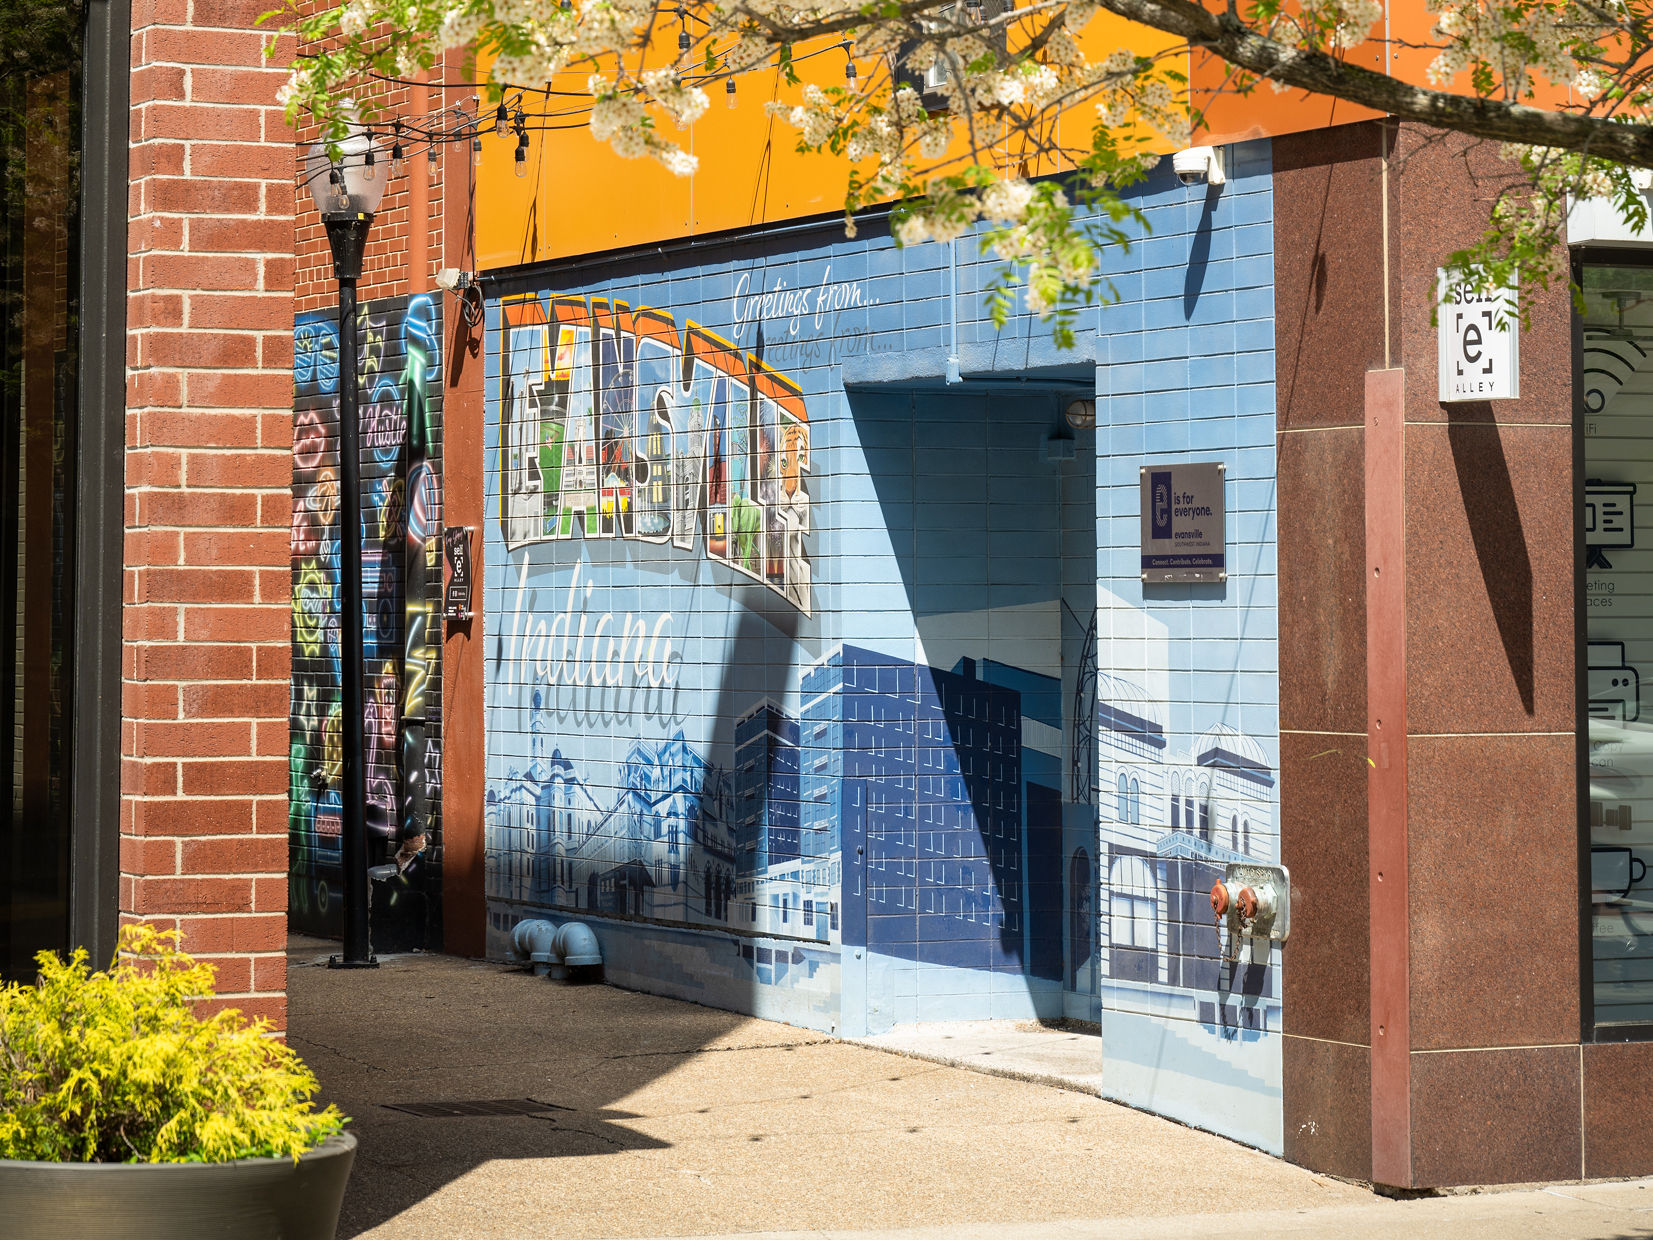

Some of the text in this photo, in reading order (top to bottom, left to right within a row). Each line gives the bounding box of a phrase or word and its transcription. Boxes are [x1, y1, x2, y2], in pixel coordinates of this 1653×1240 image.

[733, 265, 880, 338] Greetings from...
[1456, 381, 1495, 394] ALLEY
[1585, 423, 1597, 435] iFi
[500, 293, 812, 620] EVANSVILLE
[1174, 492, 1194, 505] is for
[1174, 506, 1213, 520] everyone.
[1174, 529, 1203, 539] evansville
[1587, 579, 1615, 594] eting
[1587, 598, 1613, 607] aces
[508, 550, 678, 696] Indiana
[1591, 758, 1614, 768] can
[1592, 919, 1614, 934] ffee
